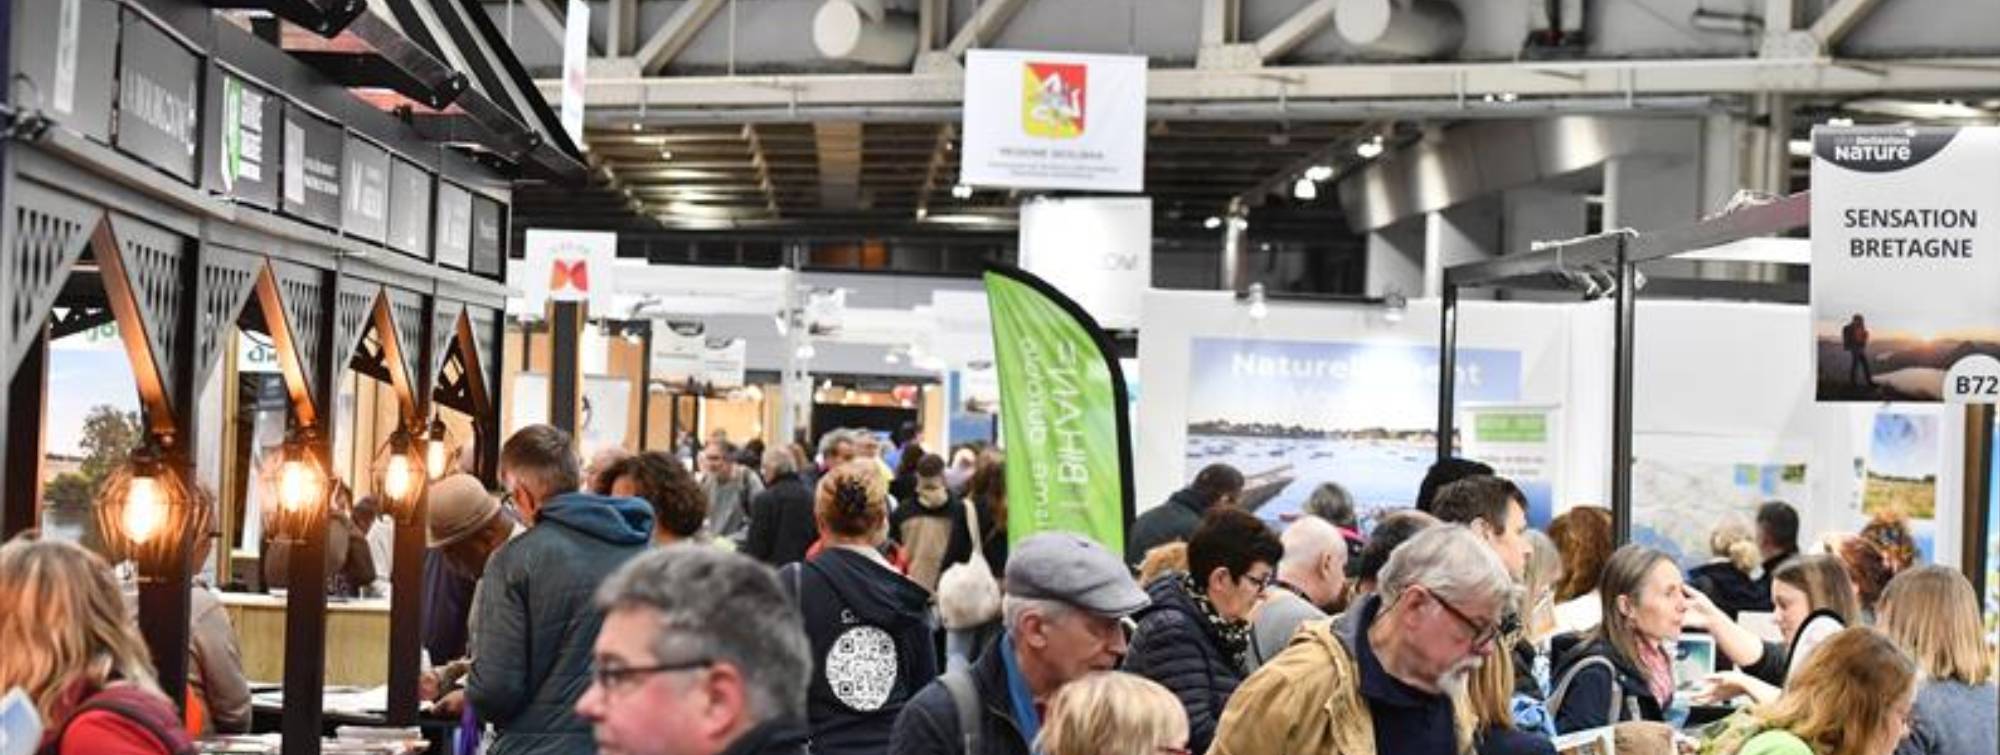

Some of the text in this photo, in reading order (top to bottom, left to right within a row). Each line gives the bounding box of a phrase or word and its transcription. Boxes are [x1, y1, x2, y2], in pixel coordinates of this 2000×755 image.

[1844, 208, 1977, 229] SENSATION
[1850, 237, 1974, 259] BRETAGNE
[1955, 375, 1998, 396] B72
